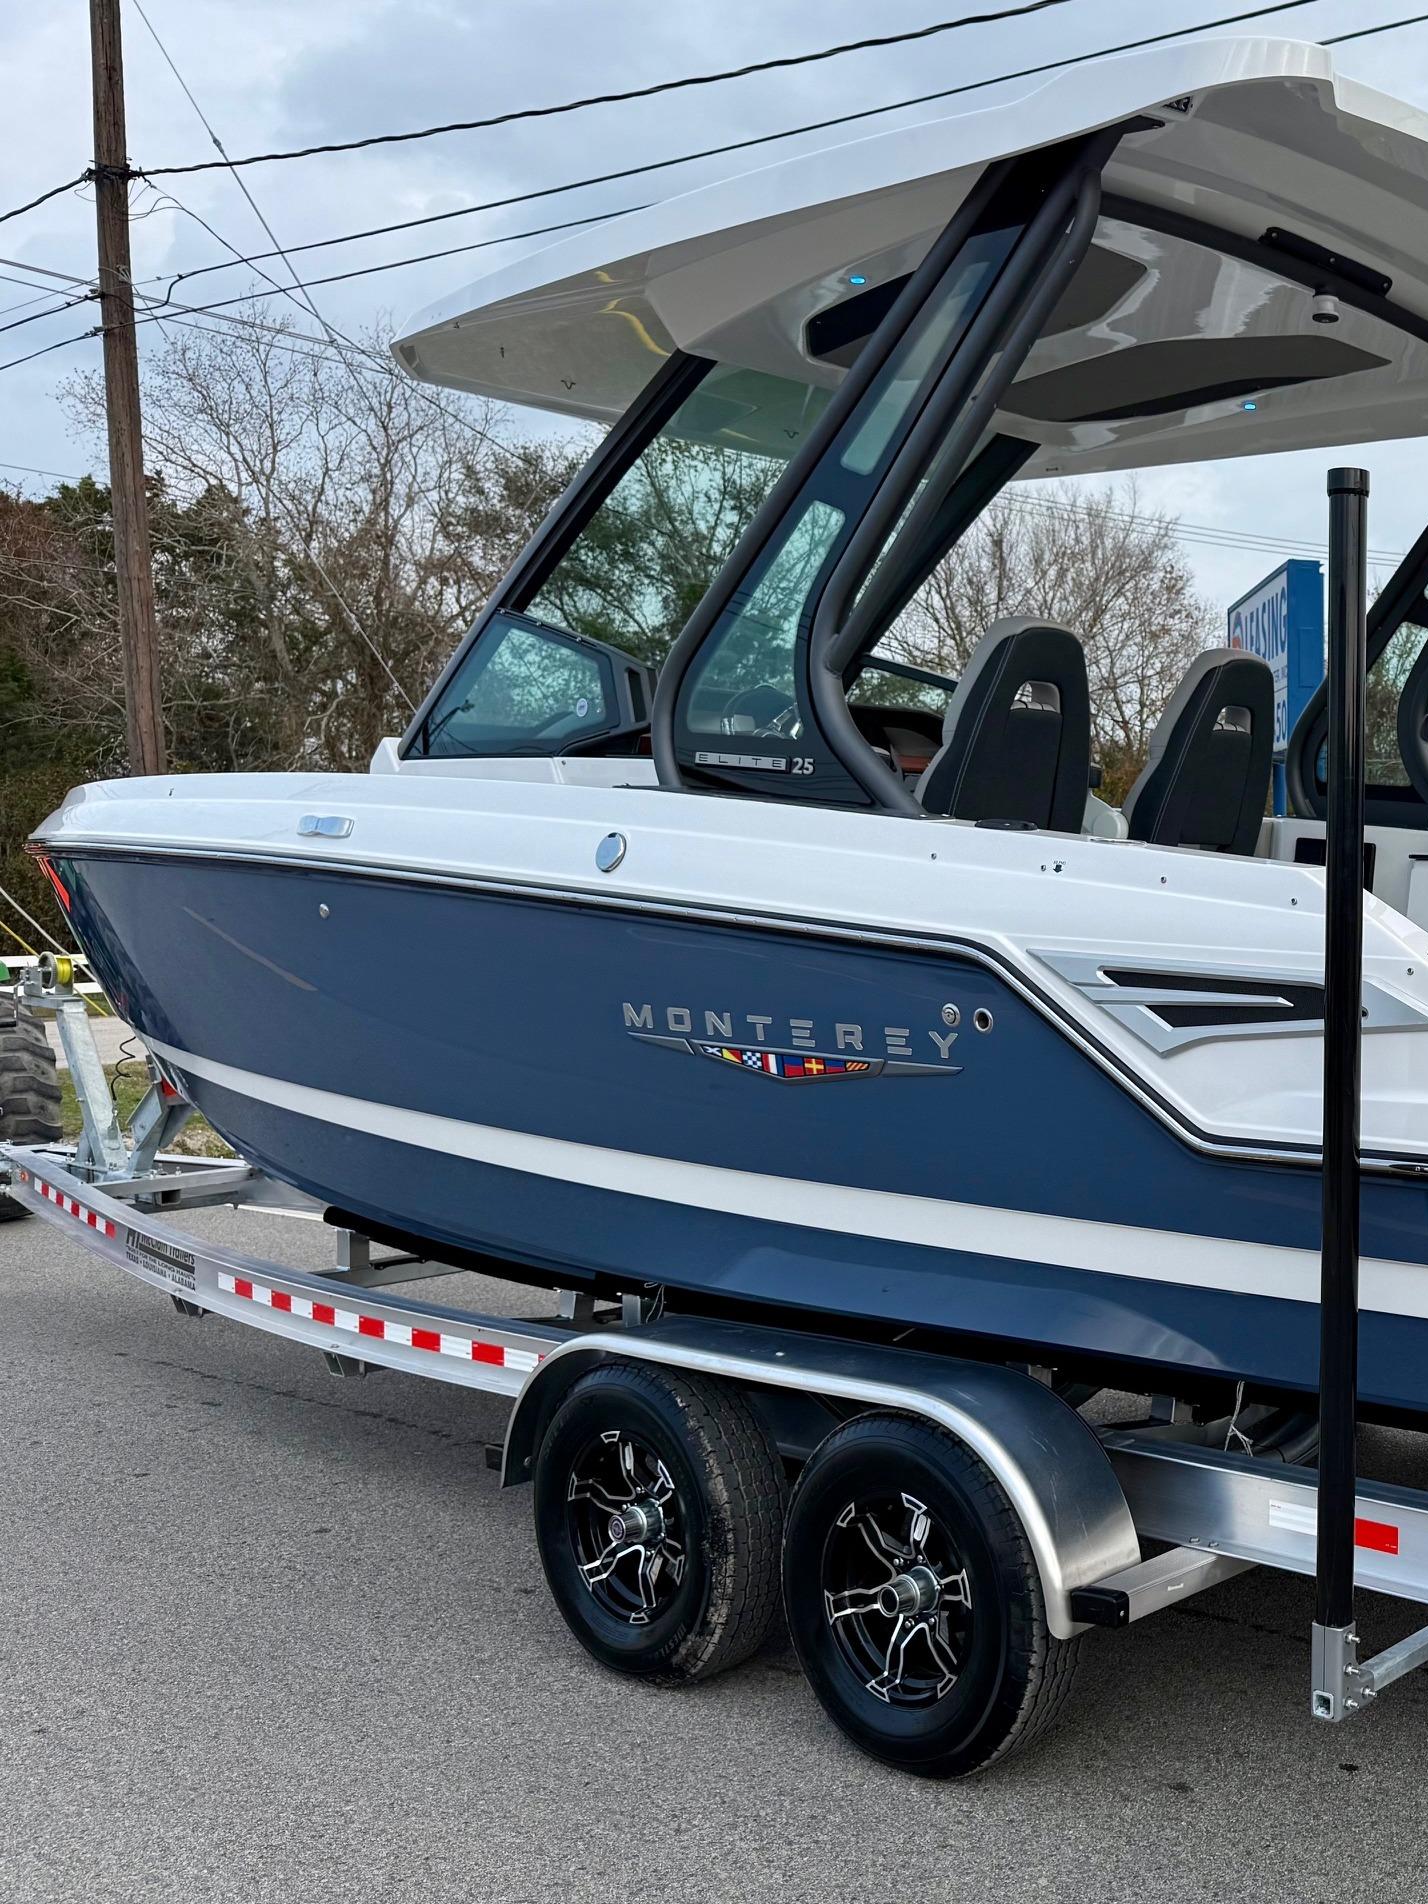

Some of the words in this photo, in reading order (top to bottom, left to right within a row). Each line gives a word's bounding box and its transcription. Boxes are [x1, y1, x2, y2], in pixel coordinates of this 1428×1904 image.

[1244, 586, 1287, 661] LEASING
[698, 753, 782, 768] ELITE
[791, 757, 815, 775] 25
[622, 1002, 959, 1059] MONTEREY
